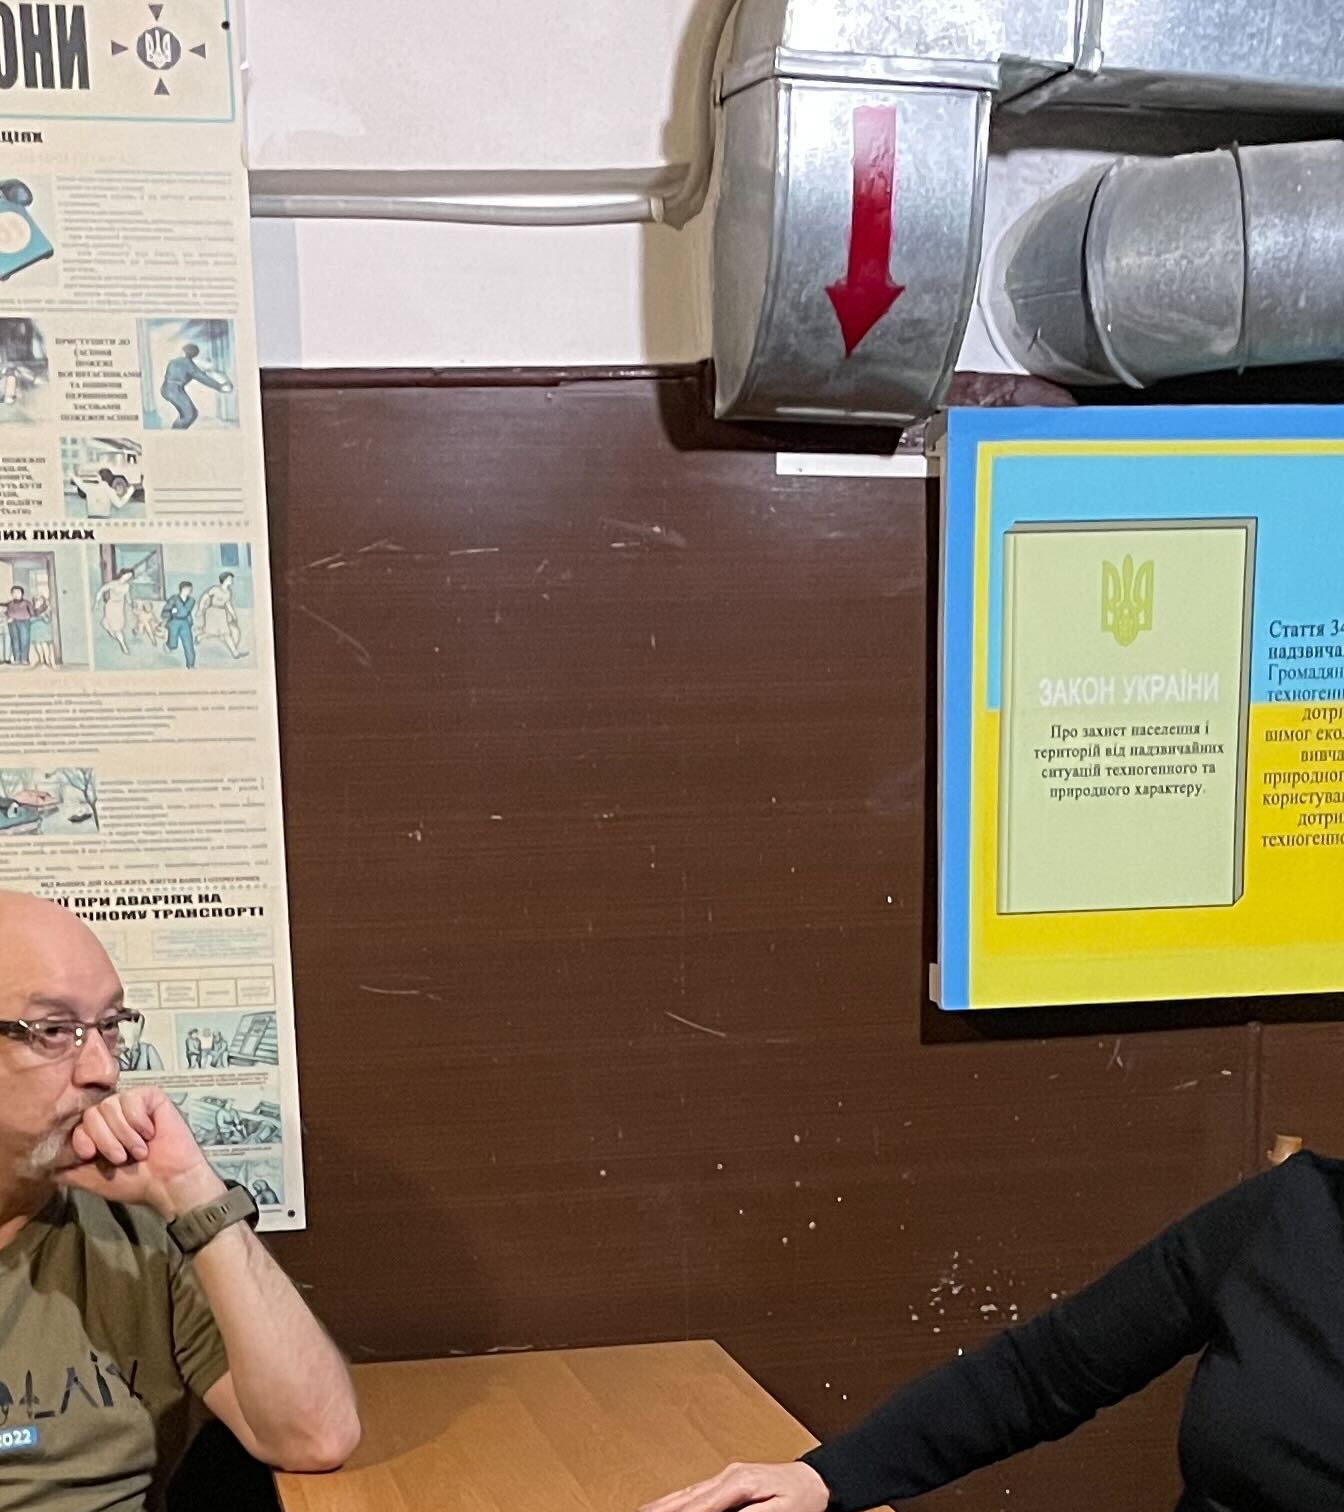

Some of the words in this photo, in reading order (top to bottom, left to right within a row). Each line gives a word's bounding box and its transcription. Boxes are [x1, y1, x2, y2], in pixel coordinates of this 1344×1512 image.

[1269, 620, 1325, 638] Стаття
[1039, 676, 1116, 706] ЗАКОН
[1122, 670, 1219, 704] УКРАЇНИ
[1051, 724, 1078, 741] Про
[1082, 726, 1127, 738] захист
[1131, 724, 1200, 737] населення
[1265, 728, 1309, 742] вимог
[1034, 743, 1101, 762] територій
[1106, 743, 1126, 758] від
[1130, 741, 1225, 757] надзвичайних
[1041, 763, 1101, 781] ситуацій
[1106, 763, 1198, 777] техногенного
[1202, 763, 1216, 774] та
[1050, 785, 1130, 801] природного
[74, 897, 110, 907] ПРИ
[198, 893, 222, 904] НА
[152, 906, 264, 919] ТРАНСПОРТІ
